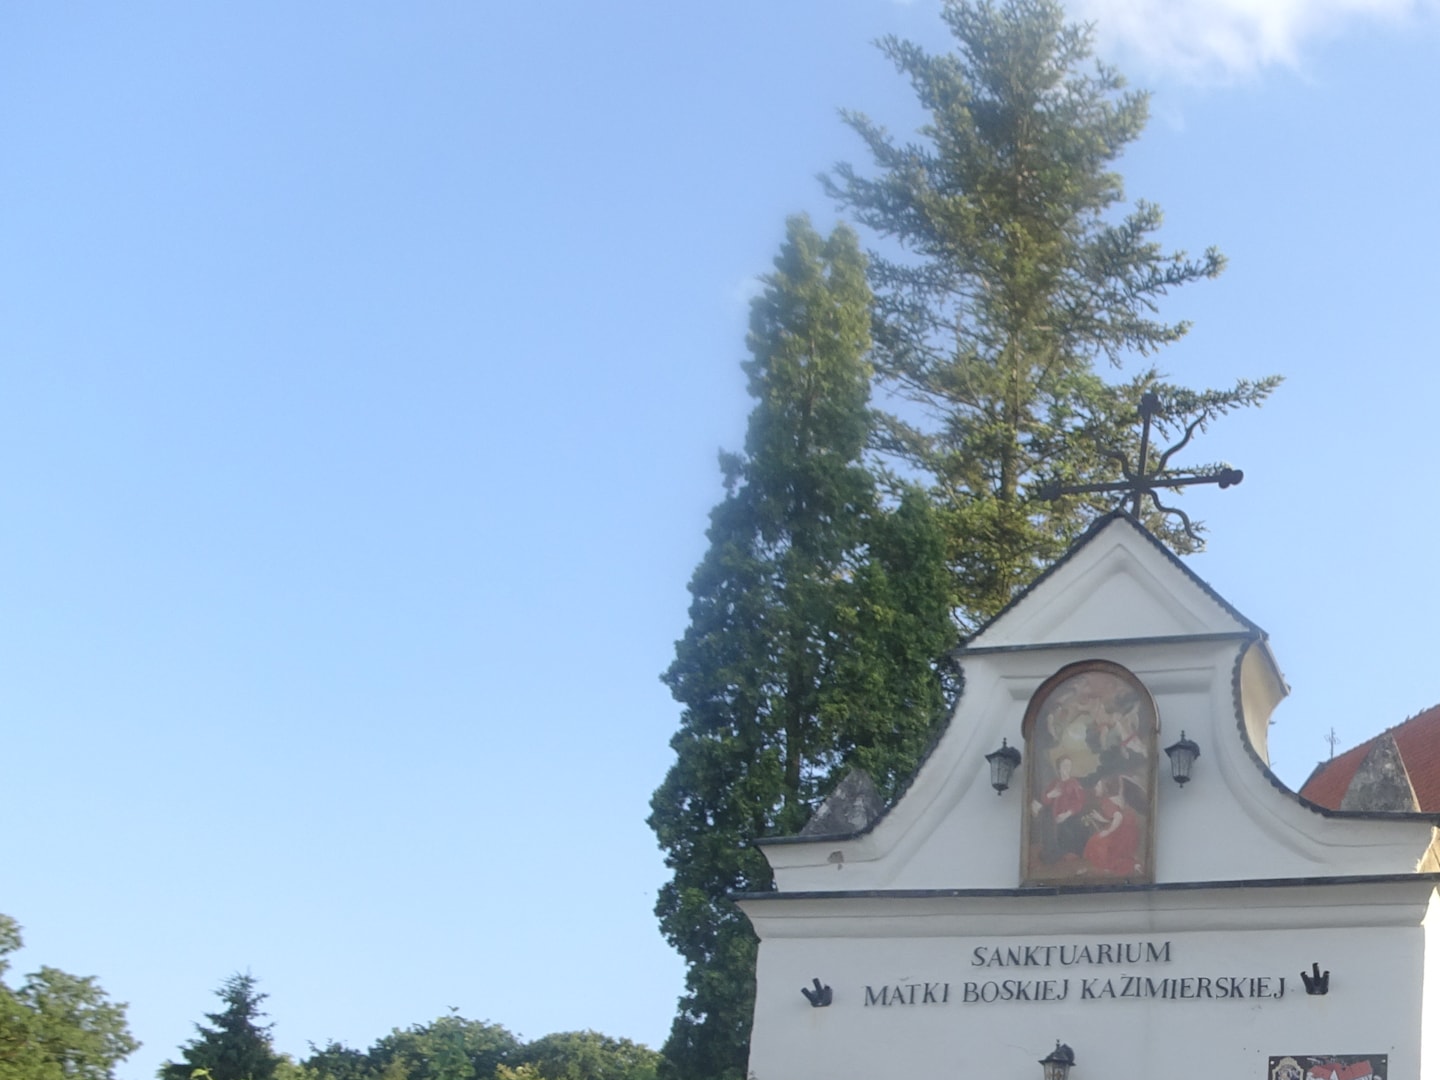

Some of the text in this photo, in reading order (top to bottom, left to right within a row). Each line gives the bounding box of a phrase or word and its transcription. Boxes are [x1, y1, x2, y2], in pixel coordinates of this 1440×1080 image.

[971, 941, 1171, 967] SANKTUARIUM
[864, 976, 1286, 1006] MATKI BOSKIEJ KAZIMIERSKIEJ
